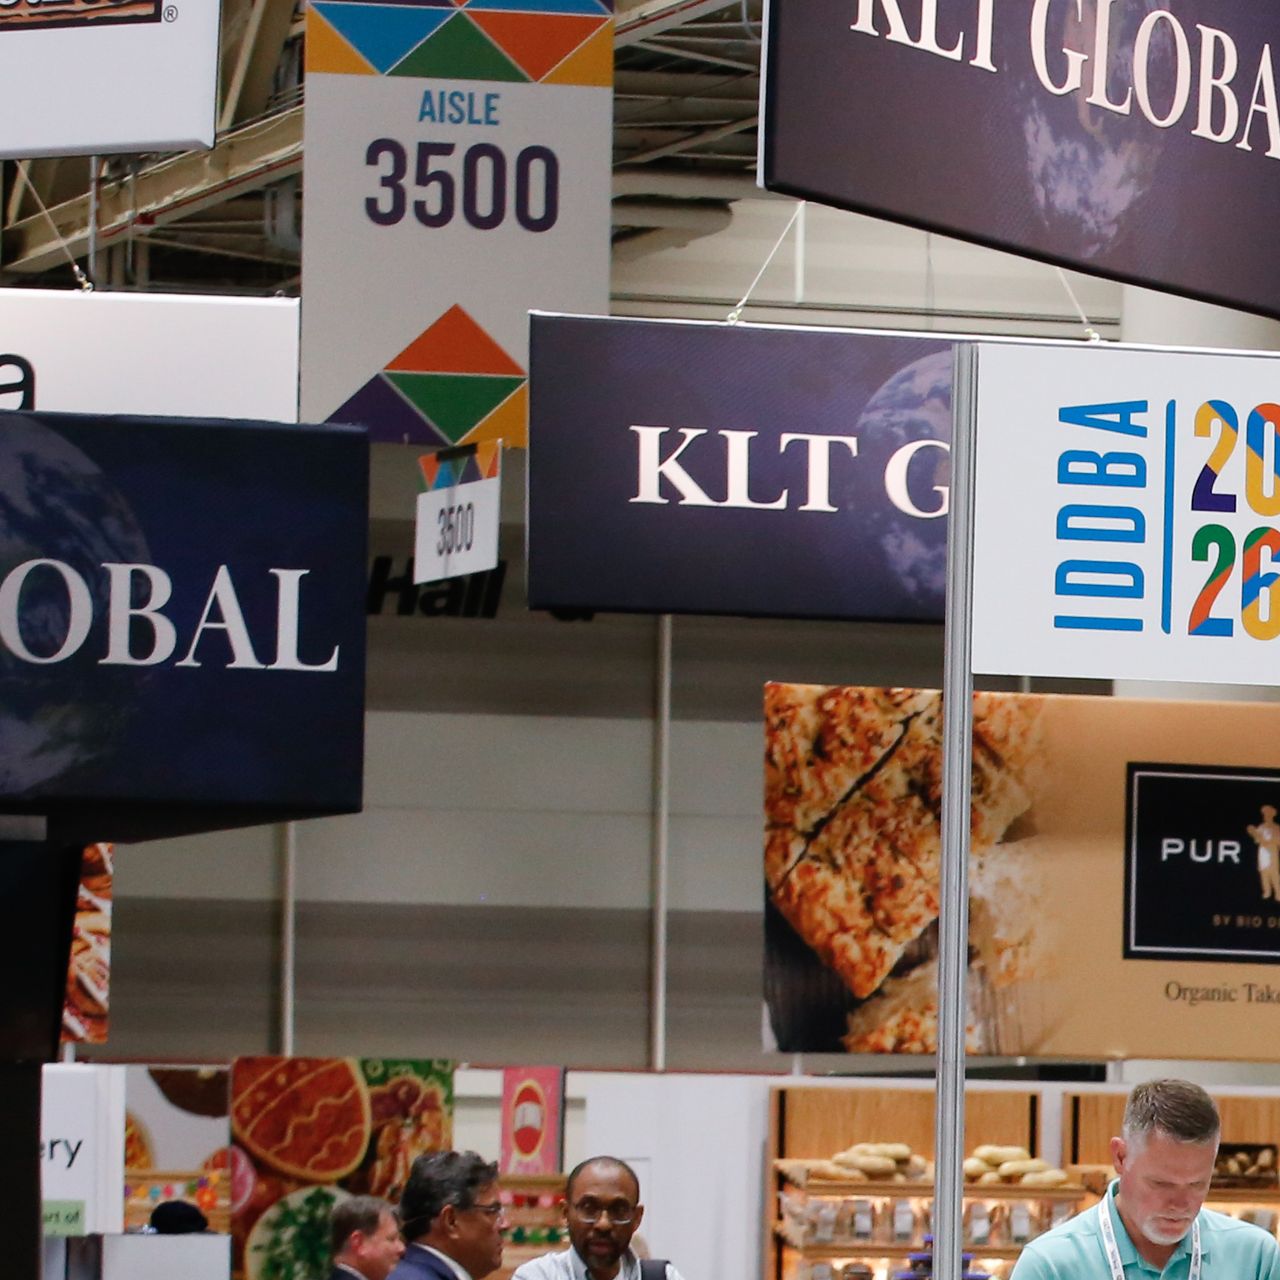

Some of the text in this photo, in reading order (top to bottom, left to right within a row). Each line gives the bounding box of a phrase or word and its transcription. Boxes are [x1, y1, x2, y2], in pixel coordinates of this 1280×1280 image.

[418, 89, 501, 127] AISLE
[365, 137, 560, 234] 3500
[628, 424, 859, 513] KLT
[1053, 399, 1149, 632] IDDBA
[0, 557, 340, 673] OBAL
[1161, 837, 1241, 864] PUR
[1164, 980, 1238, 1007] Organic
